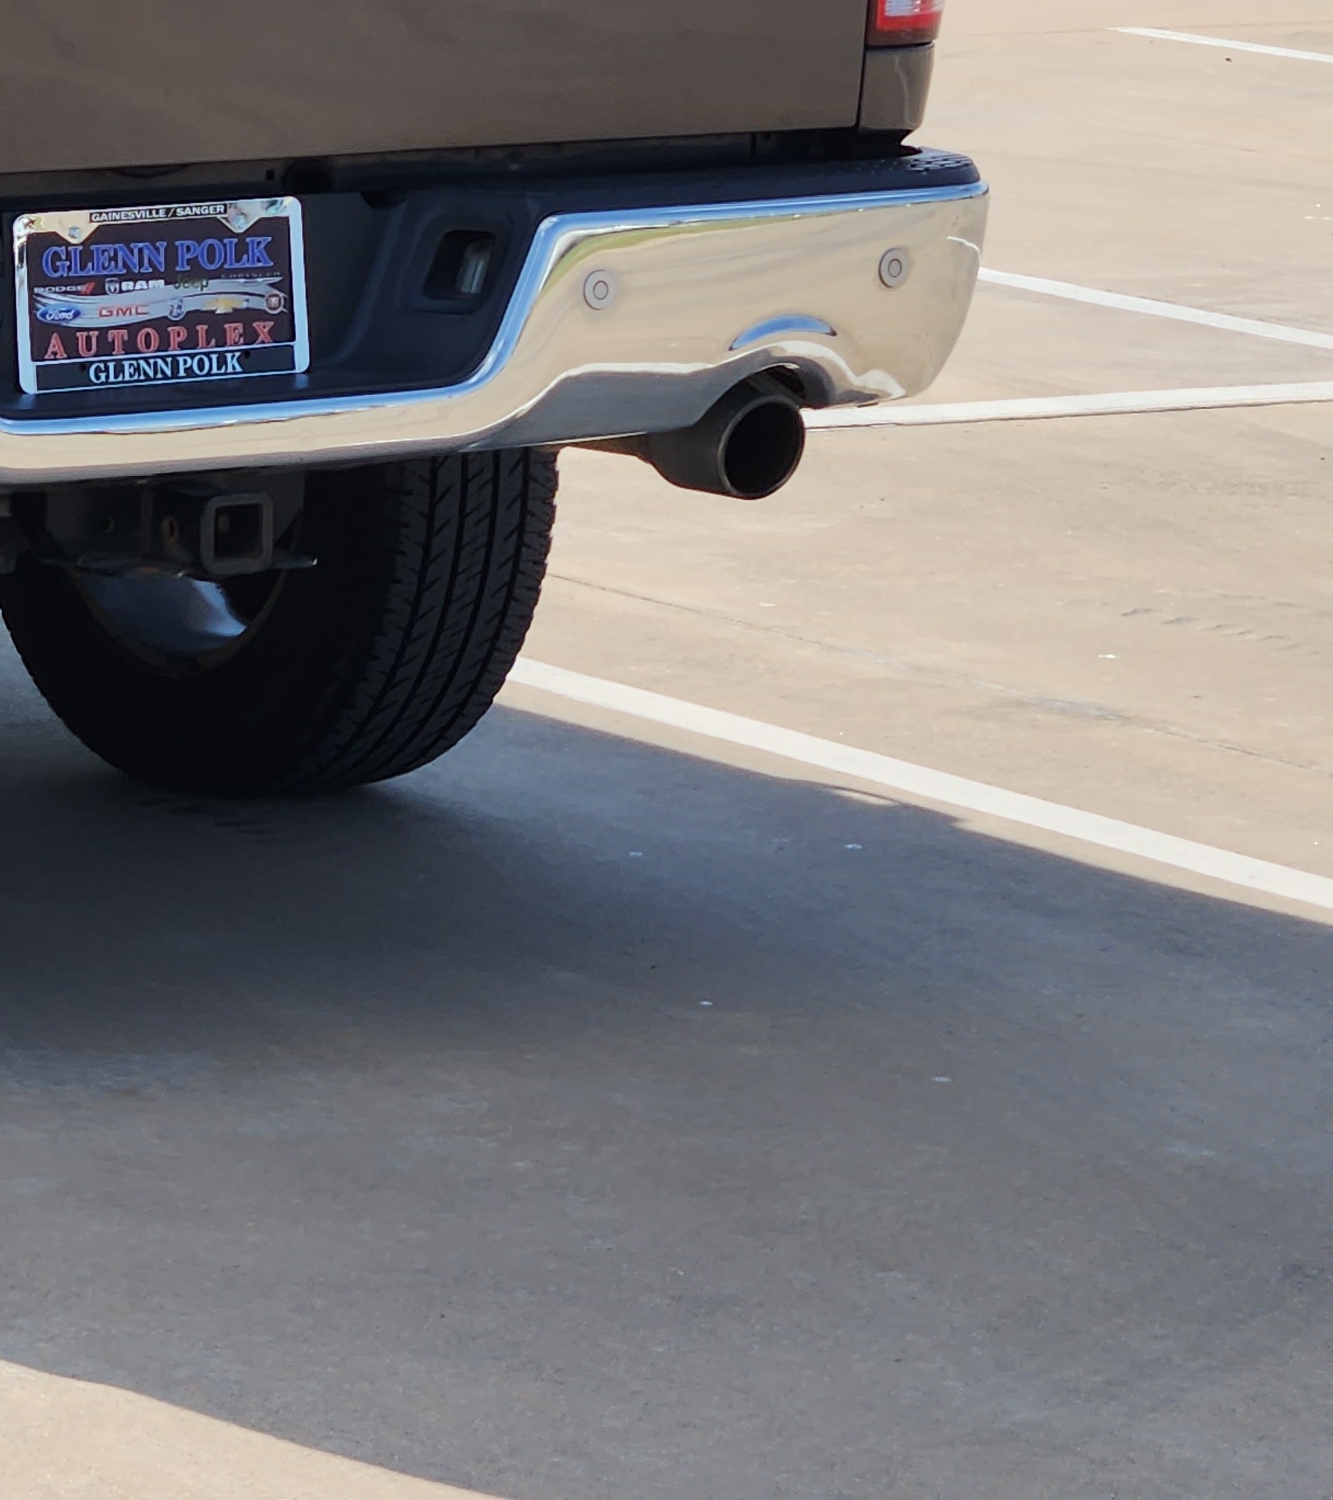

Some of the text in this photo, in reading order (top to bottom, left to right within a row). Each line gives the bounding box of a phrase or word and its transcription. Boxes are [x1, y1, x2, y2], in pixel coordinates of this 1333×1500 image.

[91, 209, 167, 223] GAINESVILLE
[175, 204, 225, 217] SANGER
[42, 236, 273, 278] GLENN POLK
[121, 279, 165, 291] RAM
[173, 277, 209, 298] Jeep
[98, 304, 150, 319] GMC
[44, 321, 275, 359] AUTOPLEX
[89, 352, 244, 384] GLENN POLK
